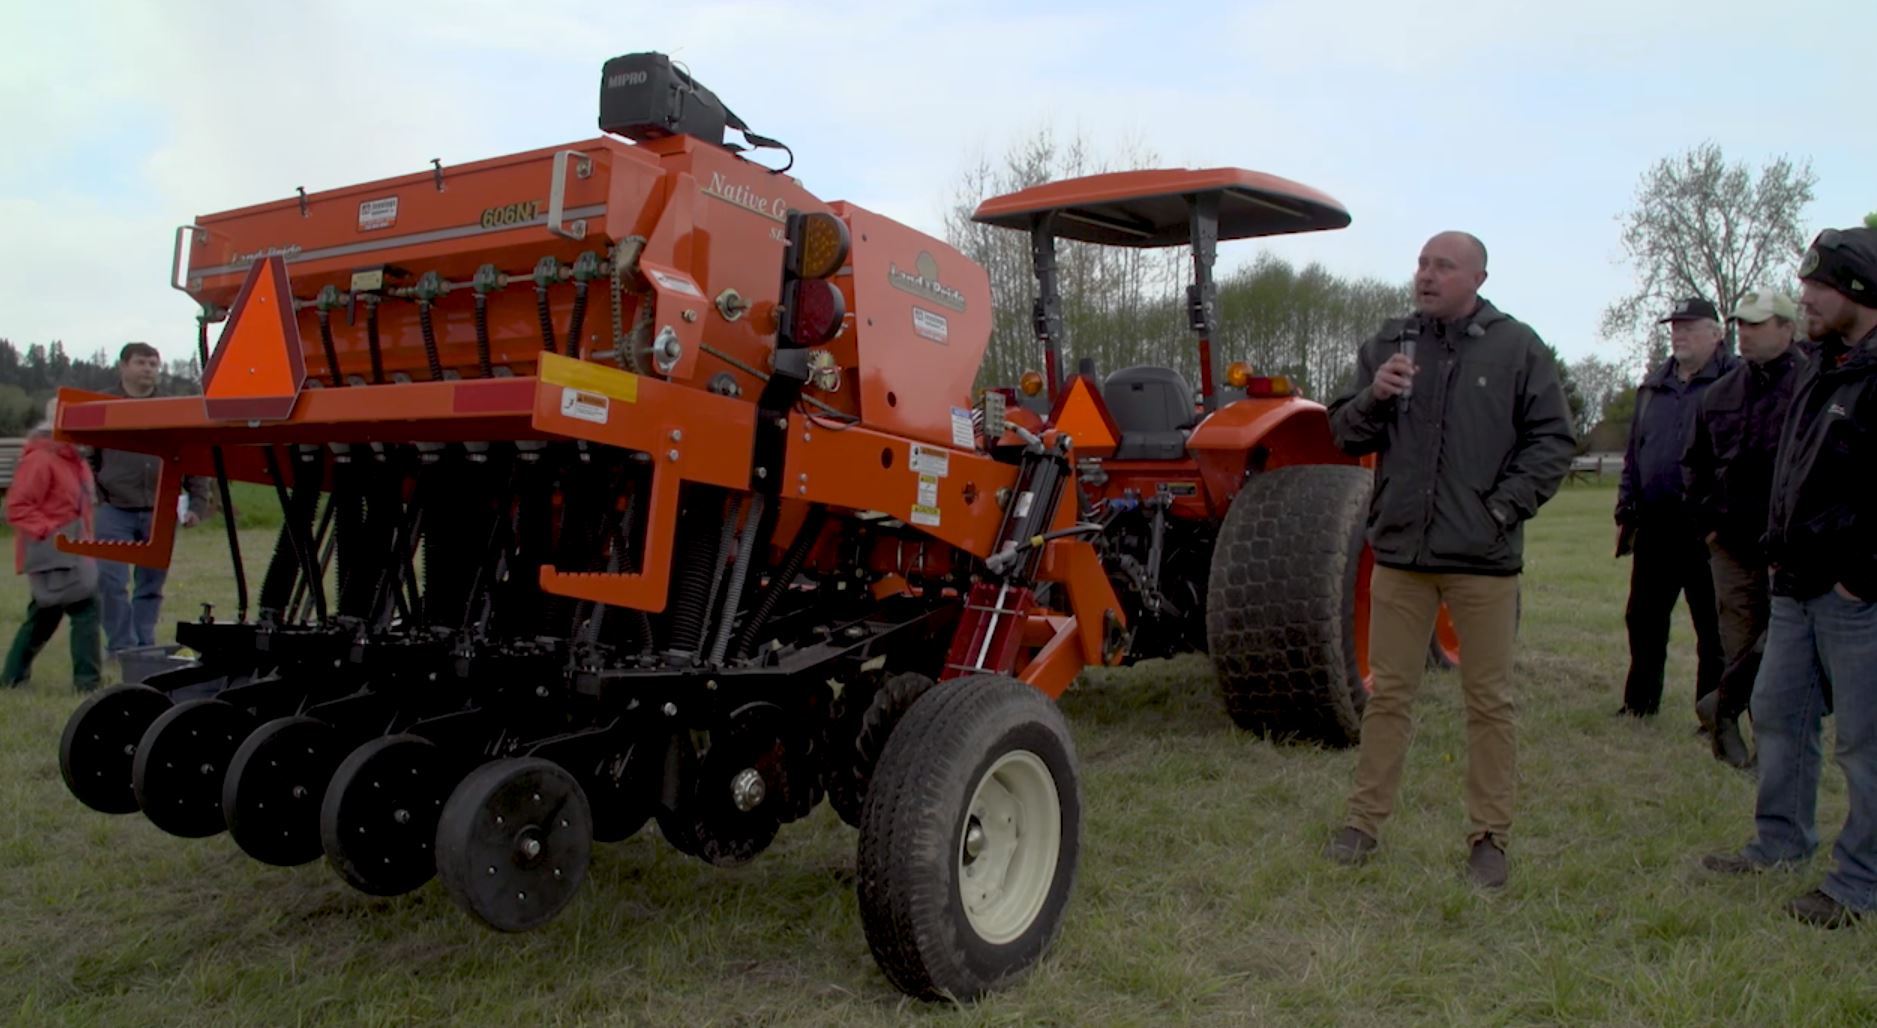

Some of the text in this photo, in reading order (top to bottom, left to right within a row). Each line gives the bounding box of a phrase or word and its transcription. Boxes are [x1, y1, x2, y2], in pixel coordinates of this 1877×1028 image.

[608, 70, 648, 88] MIPRO
[707, 171, 768, 212] Native
[481, 199, 544, 228] 606NT
